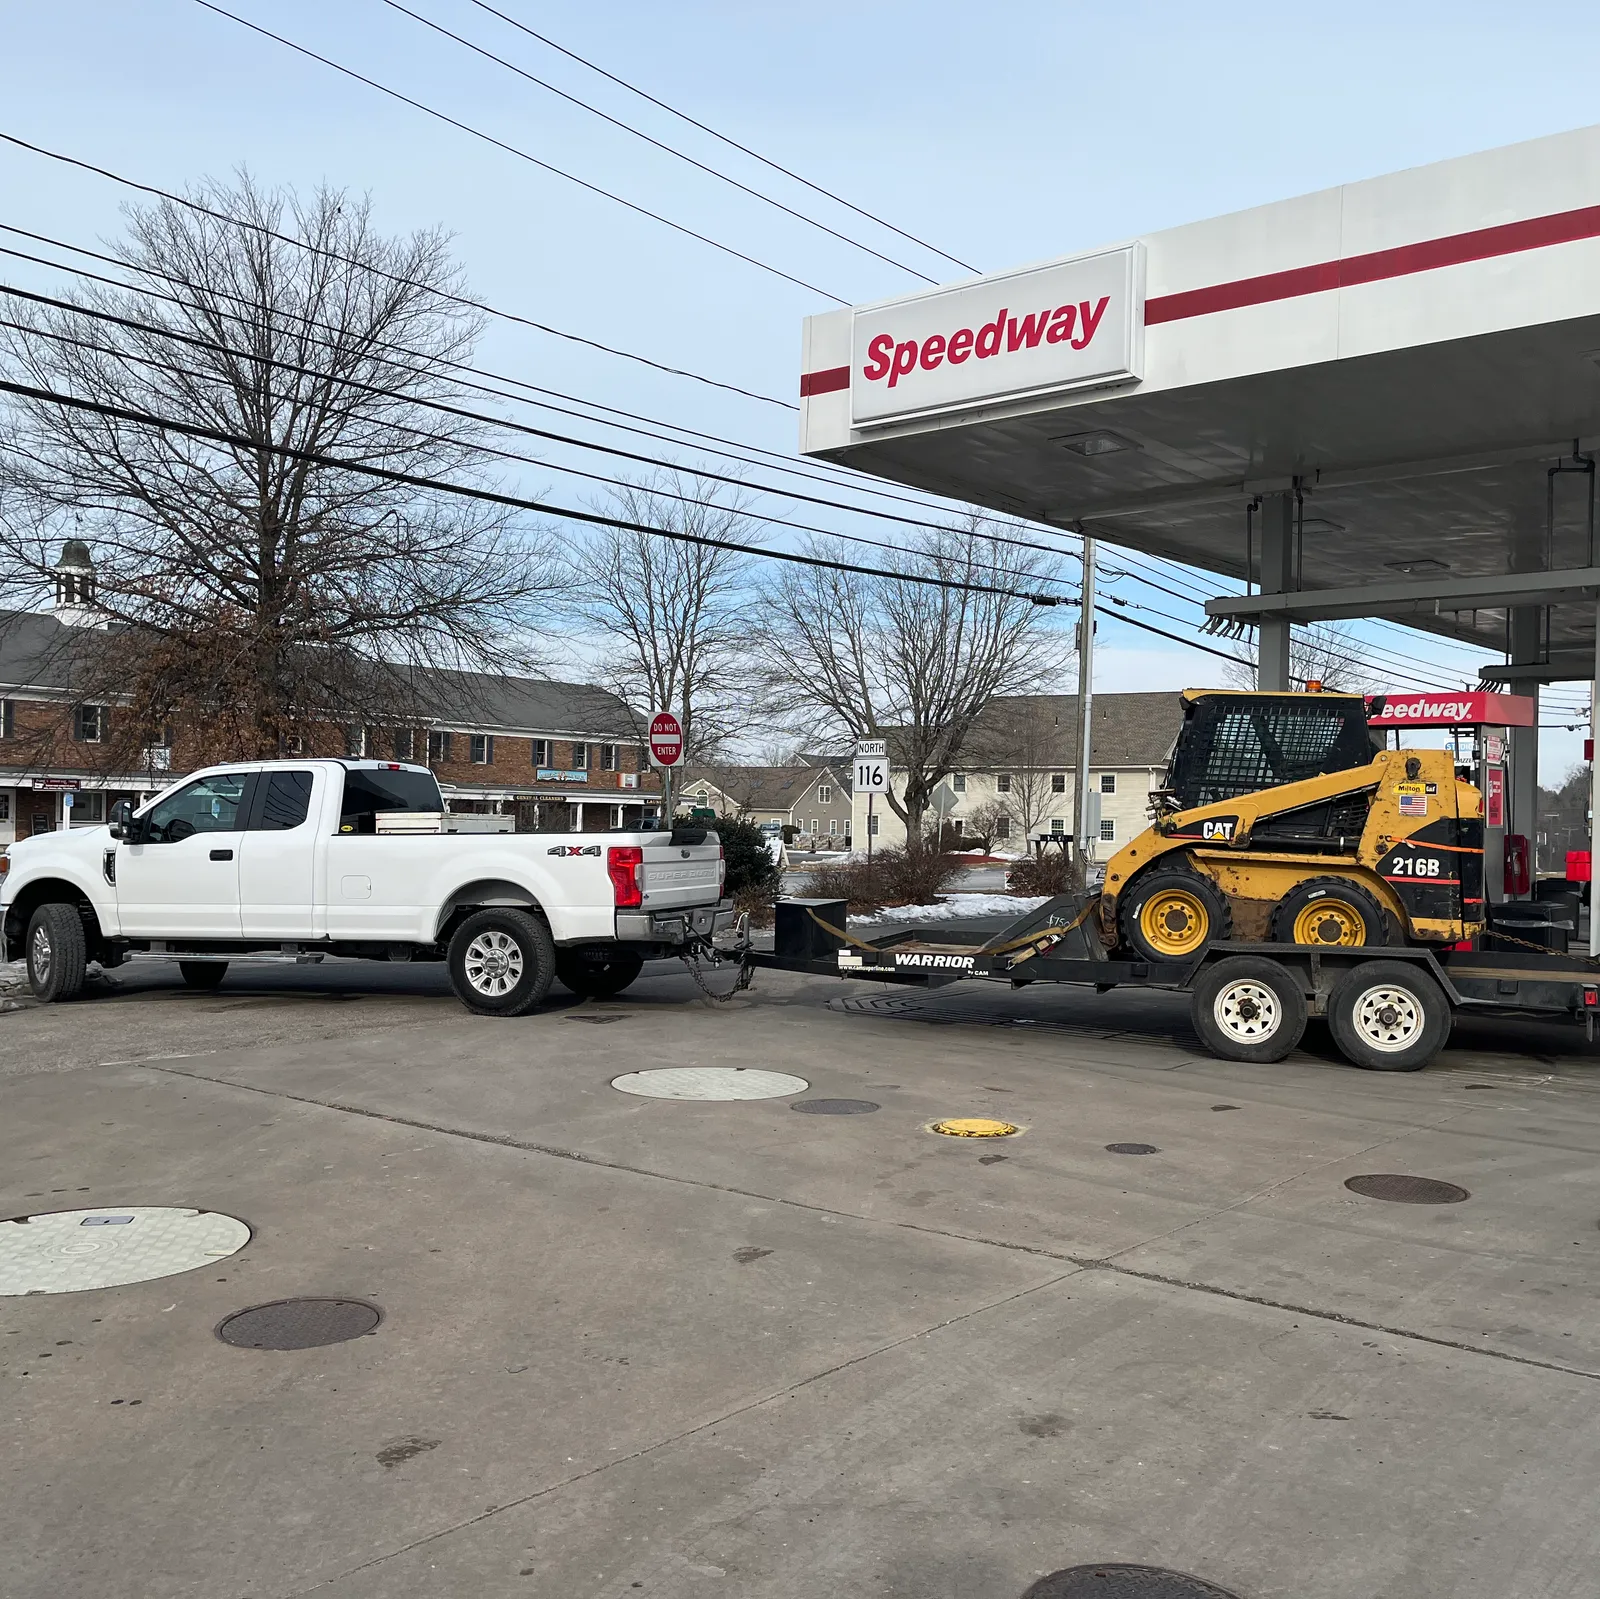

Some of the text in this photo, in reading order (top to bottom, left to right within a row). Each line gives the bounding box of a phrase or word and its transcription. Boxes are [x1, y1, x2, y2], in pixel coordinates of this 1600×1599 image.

[863, 296, 1110, 388] Speedway
[1364, 699, 1472, 721] eedway
[654, 724, 676, 732] DO NOT
[658, 746, 676, 756] ENTER
[859, 743, 884, 753] NORTH
[858, 766, 882, 786] 116
[1398, 785, 1420, 793] Milton
[1203, 822, 1233, 840] CAT
[648, 866, 716, 881] SUPER DUTY
[1392, 857, 1440, 876] 216B
[895, 954, 975, 968] WARRIOR
